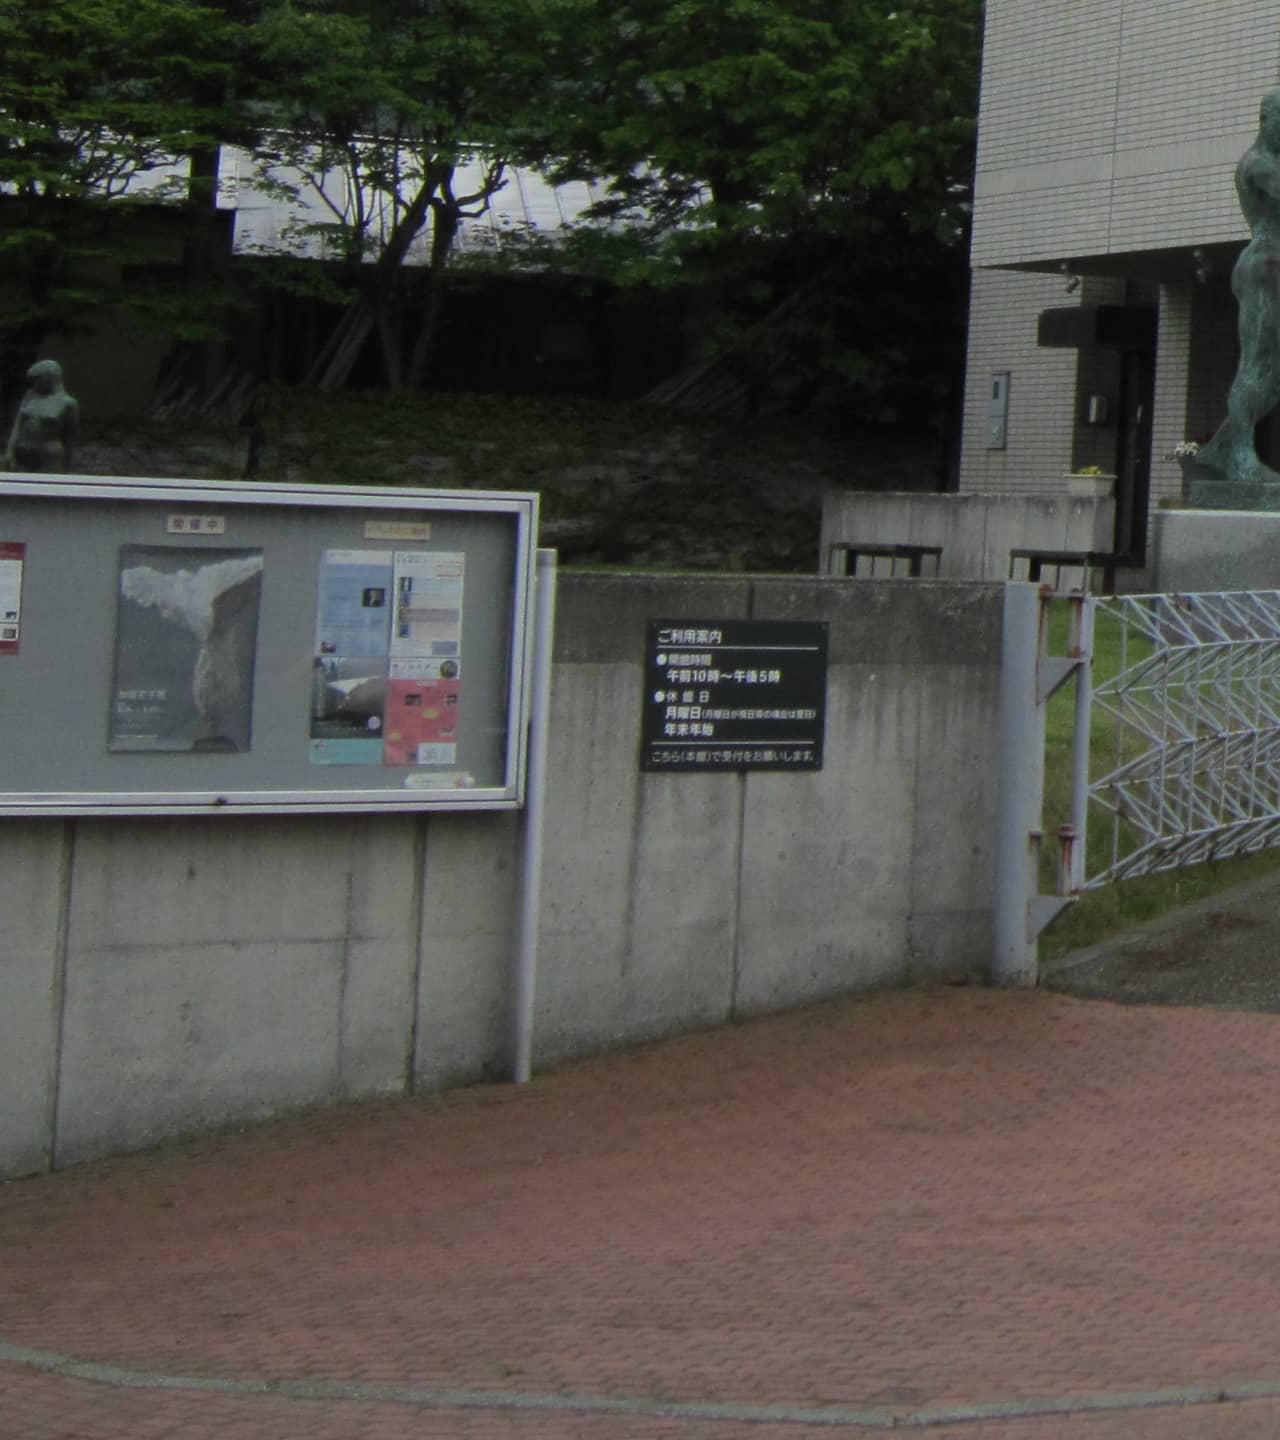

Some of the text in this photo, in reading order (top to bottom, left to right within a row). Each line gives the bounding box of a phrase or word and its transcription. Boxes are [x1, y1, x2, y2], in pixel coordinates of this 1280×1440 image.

[658, 629, 722, 644] ご利用案内
[664, 723, 714, 736] 年末年始
